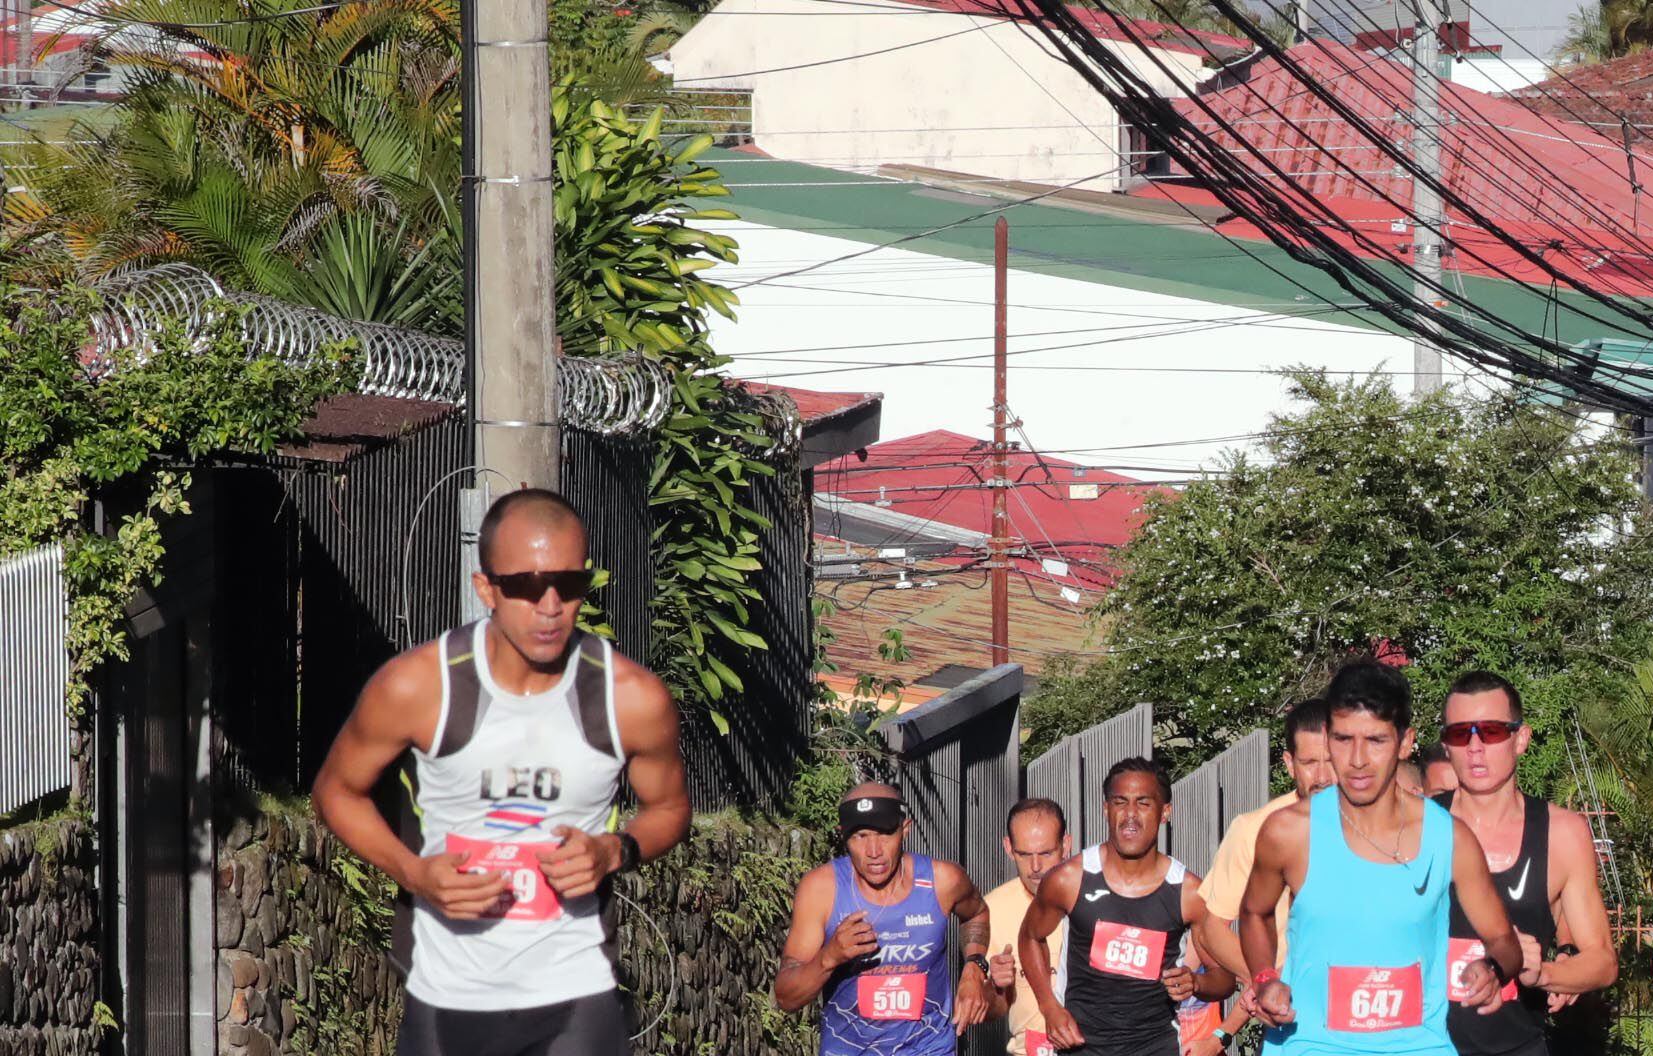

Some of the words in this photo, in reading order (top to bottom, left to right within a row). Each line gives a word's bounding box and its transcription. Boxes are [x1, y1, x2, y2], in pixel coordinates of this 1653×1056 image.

[480, 767, 562, 801] LEO
[1105, 940, 1148, 967] 638
[873, 990, 911, 1011] 510
[1351, 989, 1404, 1019] 647
